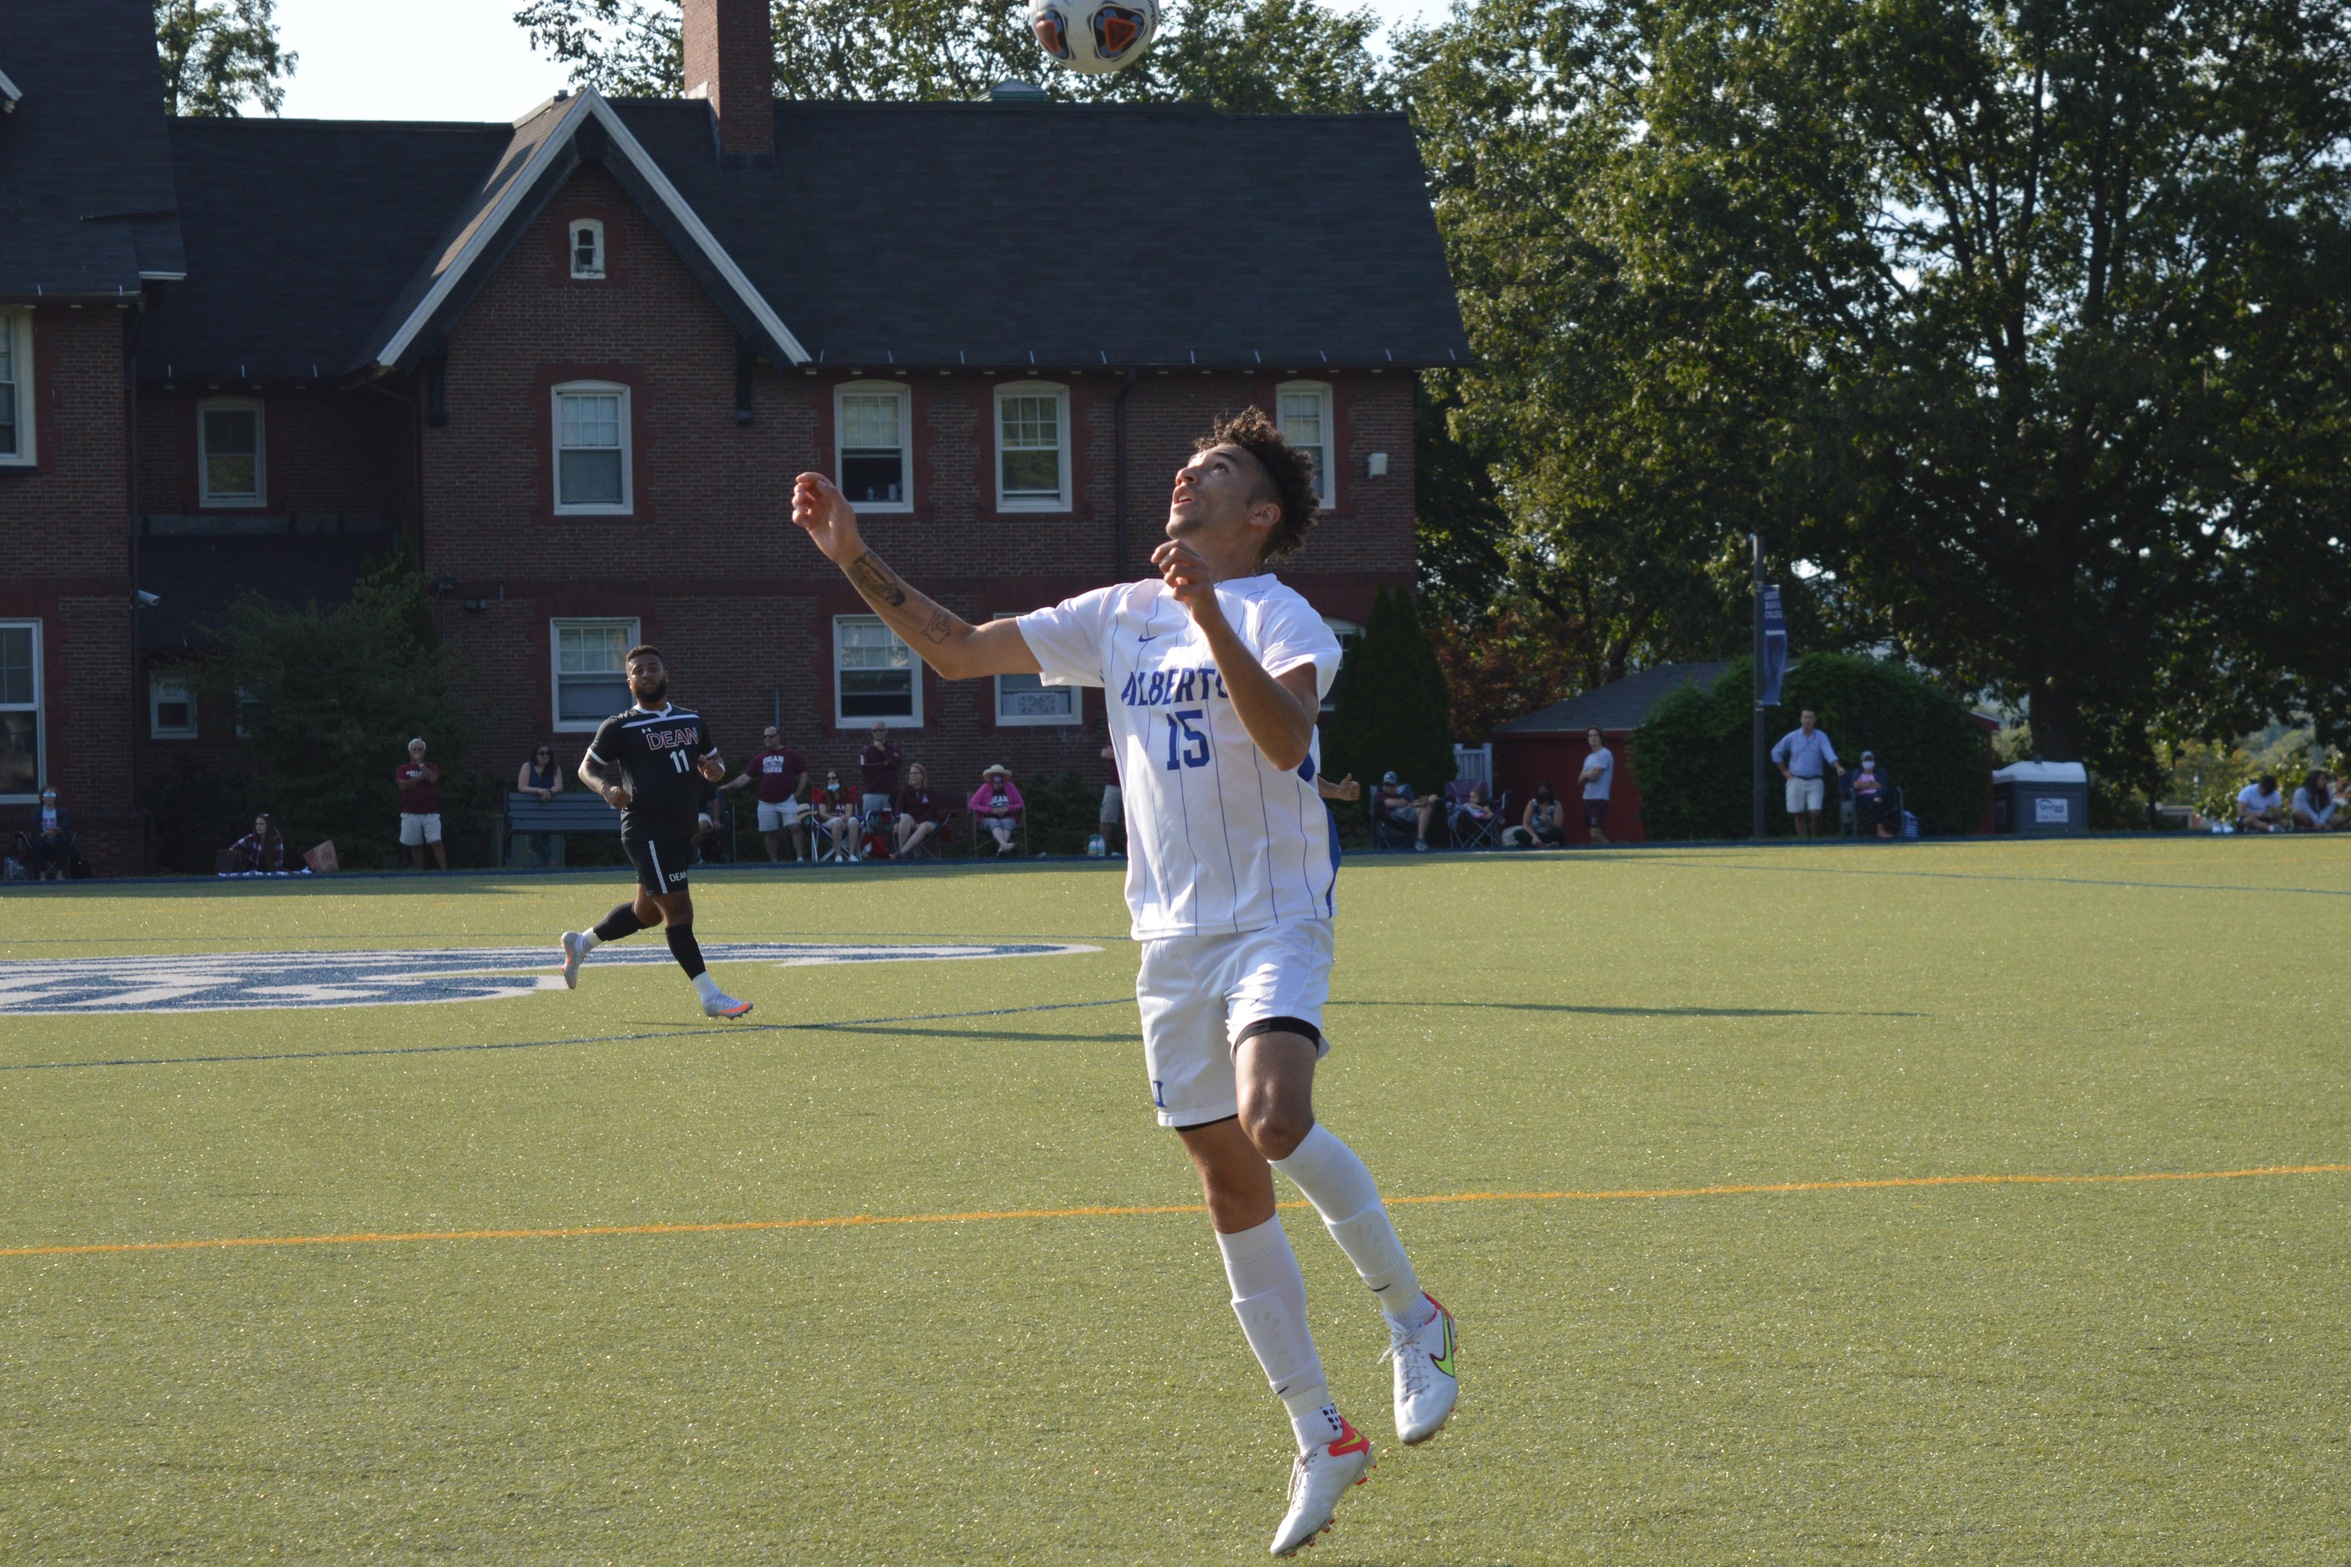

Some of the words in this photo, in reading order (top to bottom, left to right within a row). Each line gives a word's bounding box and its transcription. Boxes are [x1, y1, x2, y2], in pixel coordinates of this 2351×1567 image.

[646, 727, 699, 751] DEAN
[1166, 709, 1210, 771] 15
[669, 749, 690, 773] 11
